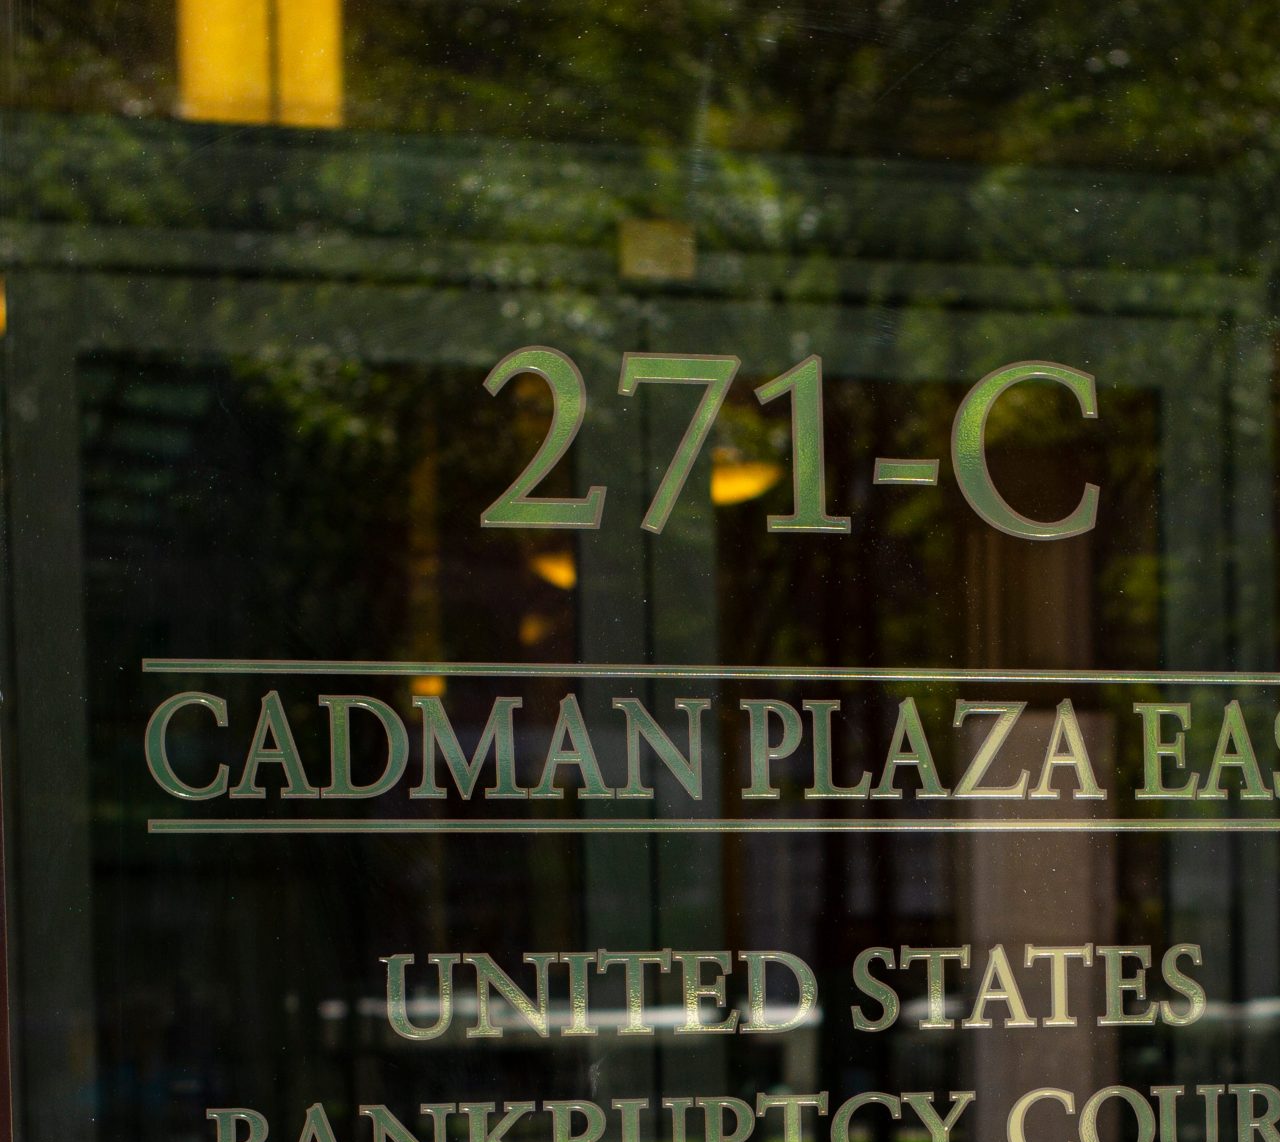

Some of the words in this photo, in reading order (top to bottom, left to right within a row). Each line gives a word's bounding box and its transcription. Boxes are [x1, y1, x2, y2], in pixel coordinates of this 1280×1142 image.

[481, 345, 1099, 540] 271-C
[144, 691, 711, 801] CADMAN
[740, 697, 1107, 801] PLAZA
[380, 948, 818, 1040] UNITED
[850, 943, 1206, 1033] STATES
